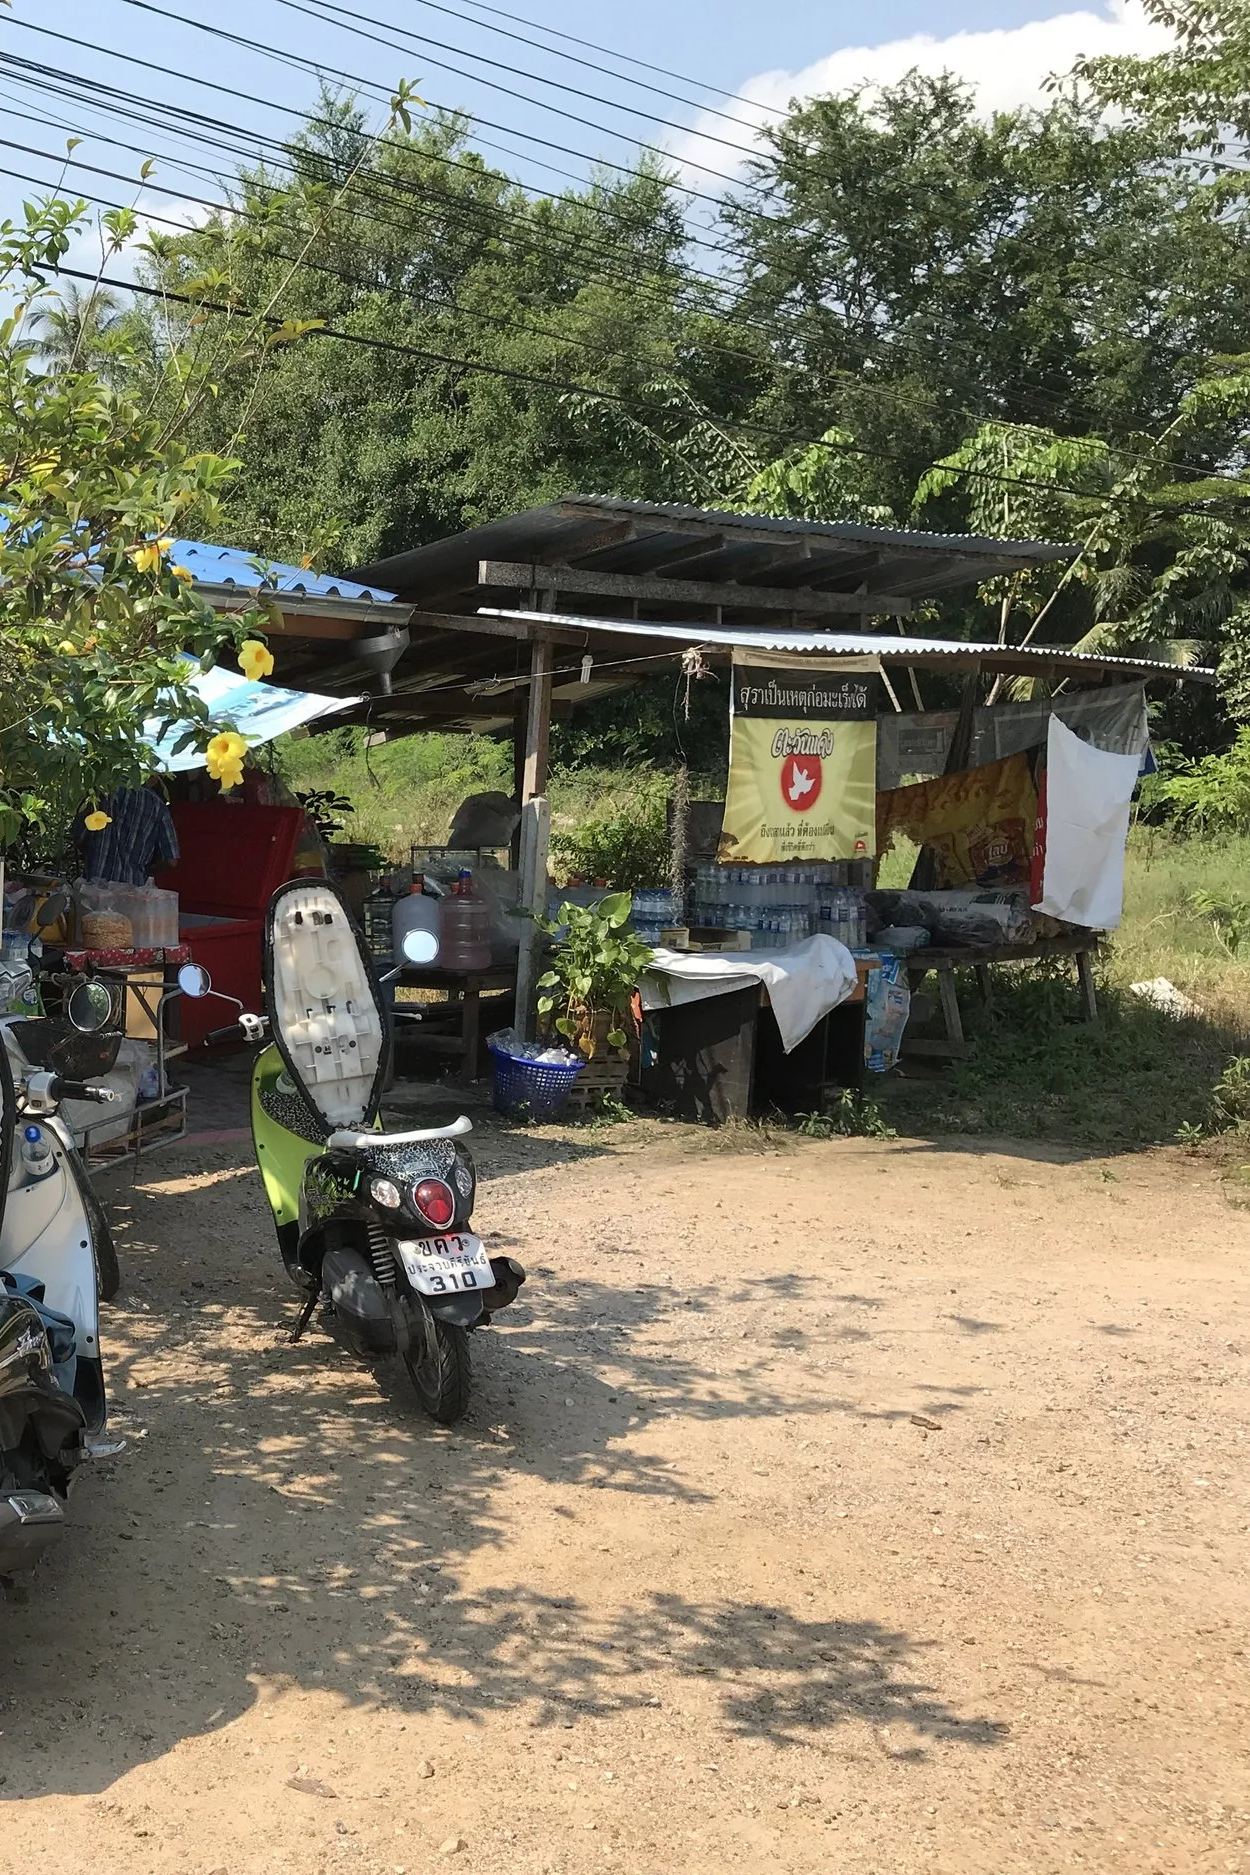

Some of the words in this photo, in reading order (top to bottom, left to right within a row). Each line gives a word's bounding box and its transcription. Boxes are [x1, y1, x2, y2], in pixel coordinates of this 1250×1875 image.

[771, 727, 834, 758] ตะวันแดง
[408, 1253, 487, 1275] ประจวบคีรีขันธ์
[430, 1271, 477, 1292] 310
